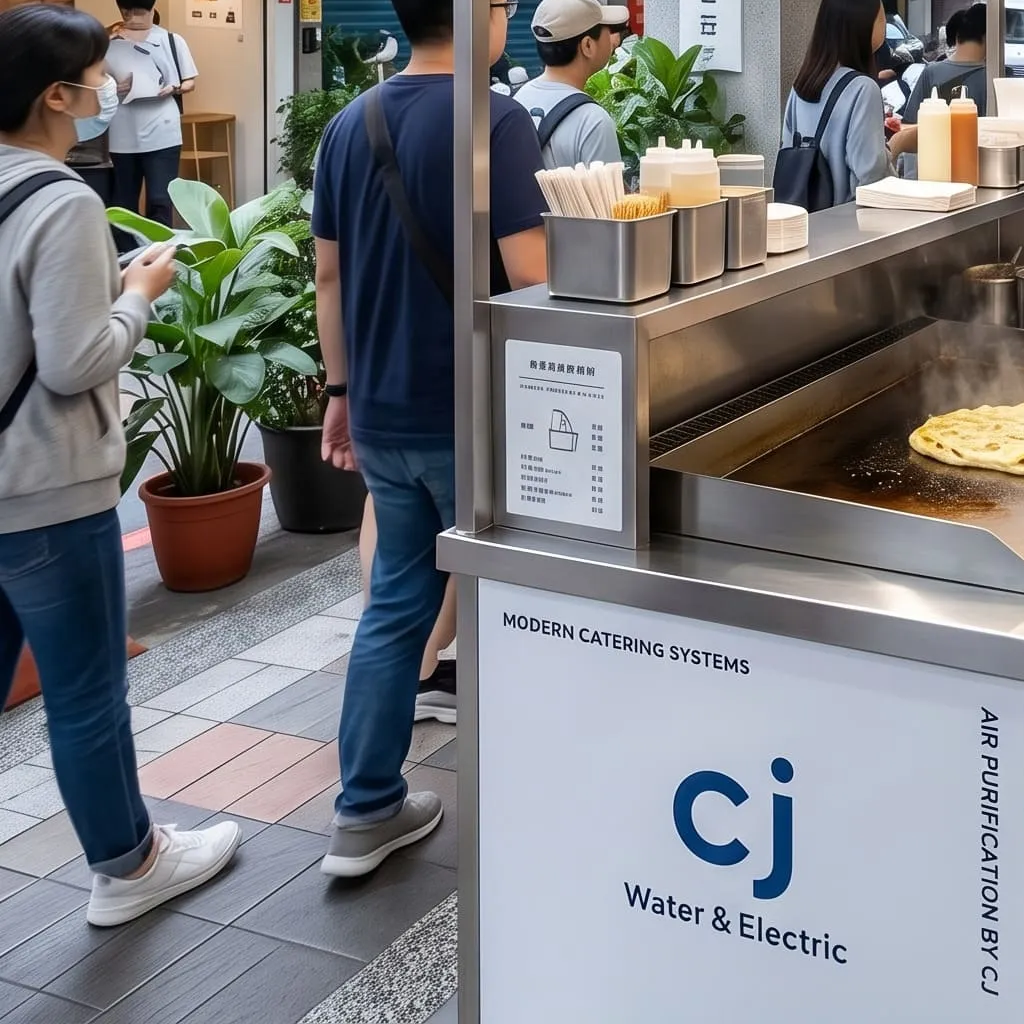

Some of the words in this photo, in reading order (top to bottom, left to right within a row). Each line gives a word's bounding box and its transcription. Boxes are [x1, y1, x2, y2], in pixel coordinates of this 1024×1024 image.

[503, 611, 574, 641] MODERN
[578, 627, 664, 658] CATERING
[669, 645, 750, 675] SYSTEMS
[980, 706, 999, 749] AIR
[672, 757, 794, 900] cj
[980, 754, 999, 922] PURIFICATION
[623, 881, 705, 925] Water
[711, 905, 732, 935] &
[739, 912, 848, 965] Electric
[980, 927, 999, 961] BY
[980, 965, 999, 997] CJ
